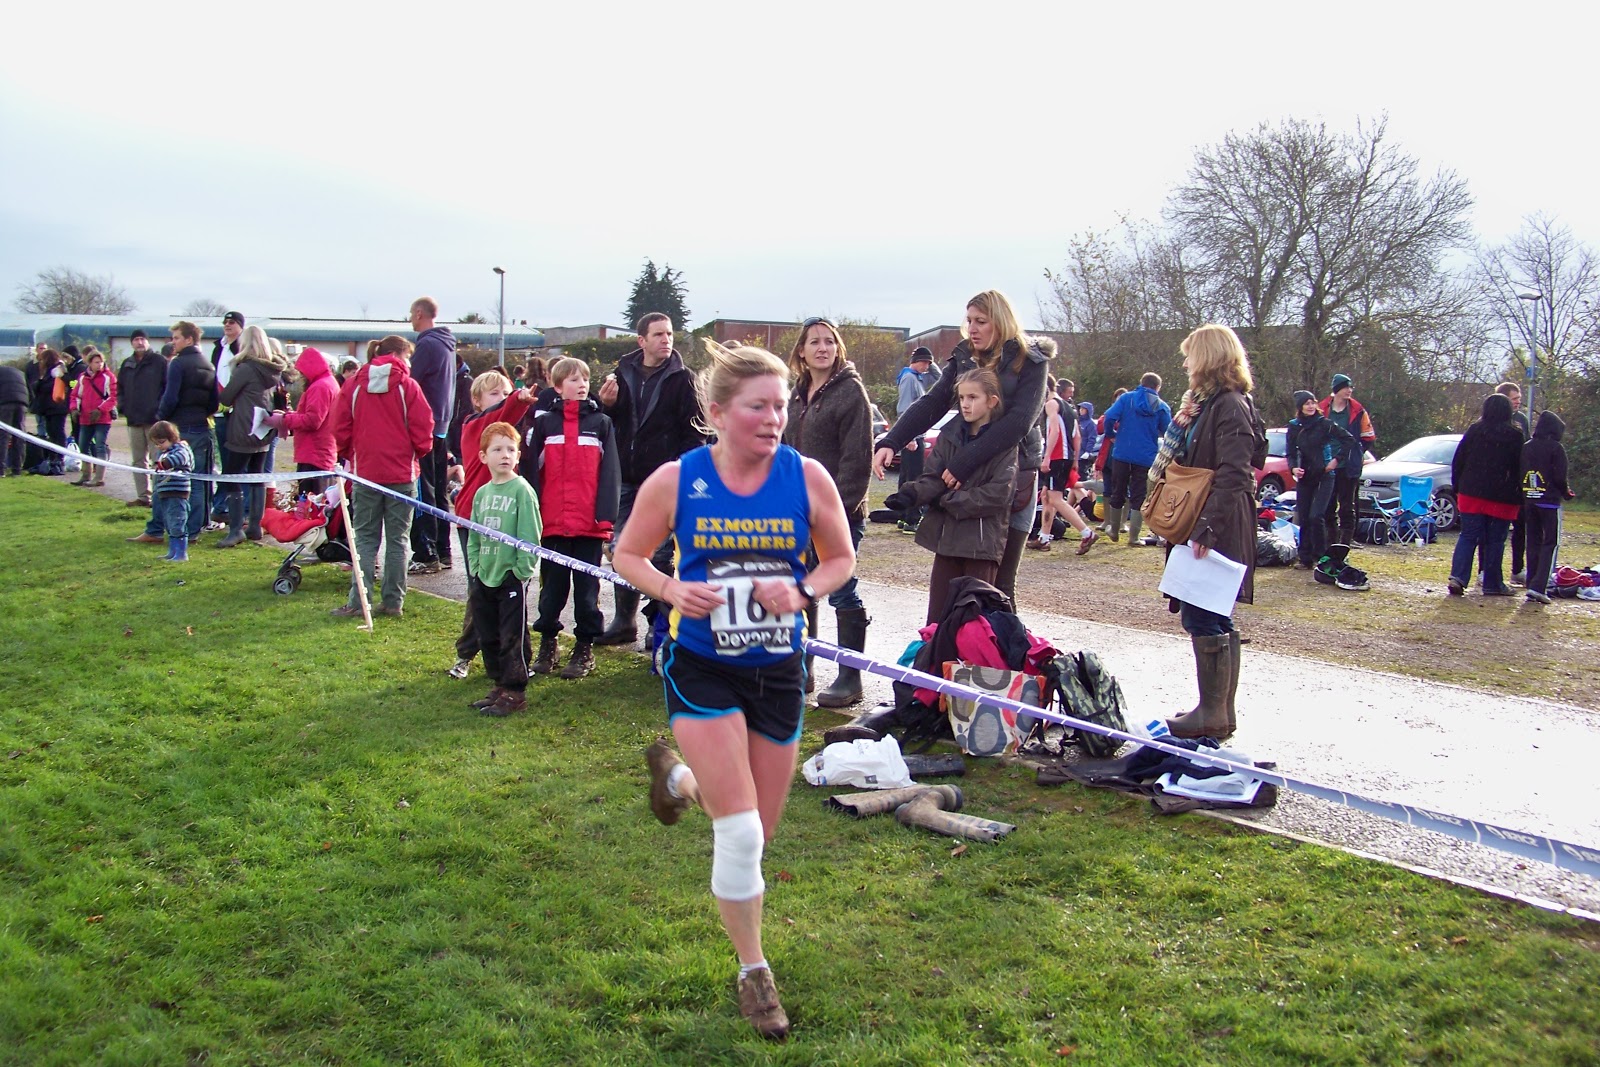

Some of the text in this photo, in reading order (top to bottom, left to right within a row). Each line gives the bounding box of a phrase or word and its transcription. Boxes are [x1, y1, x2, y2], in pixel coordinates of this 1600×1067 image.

[695, 516, 795, 534] EXMOUTH
[693, 533, 797, 550] HARRIERS
[727, 585, 782, 626] 16
